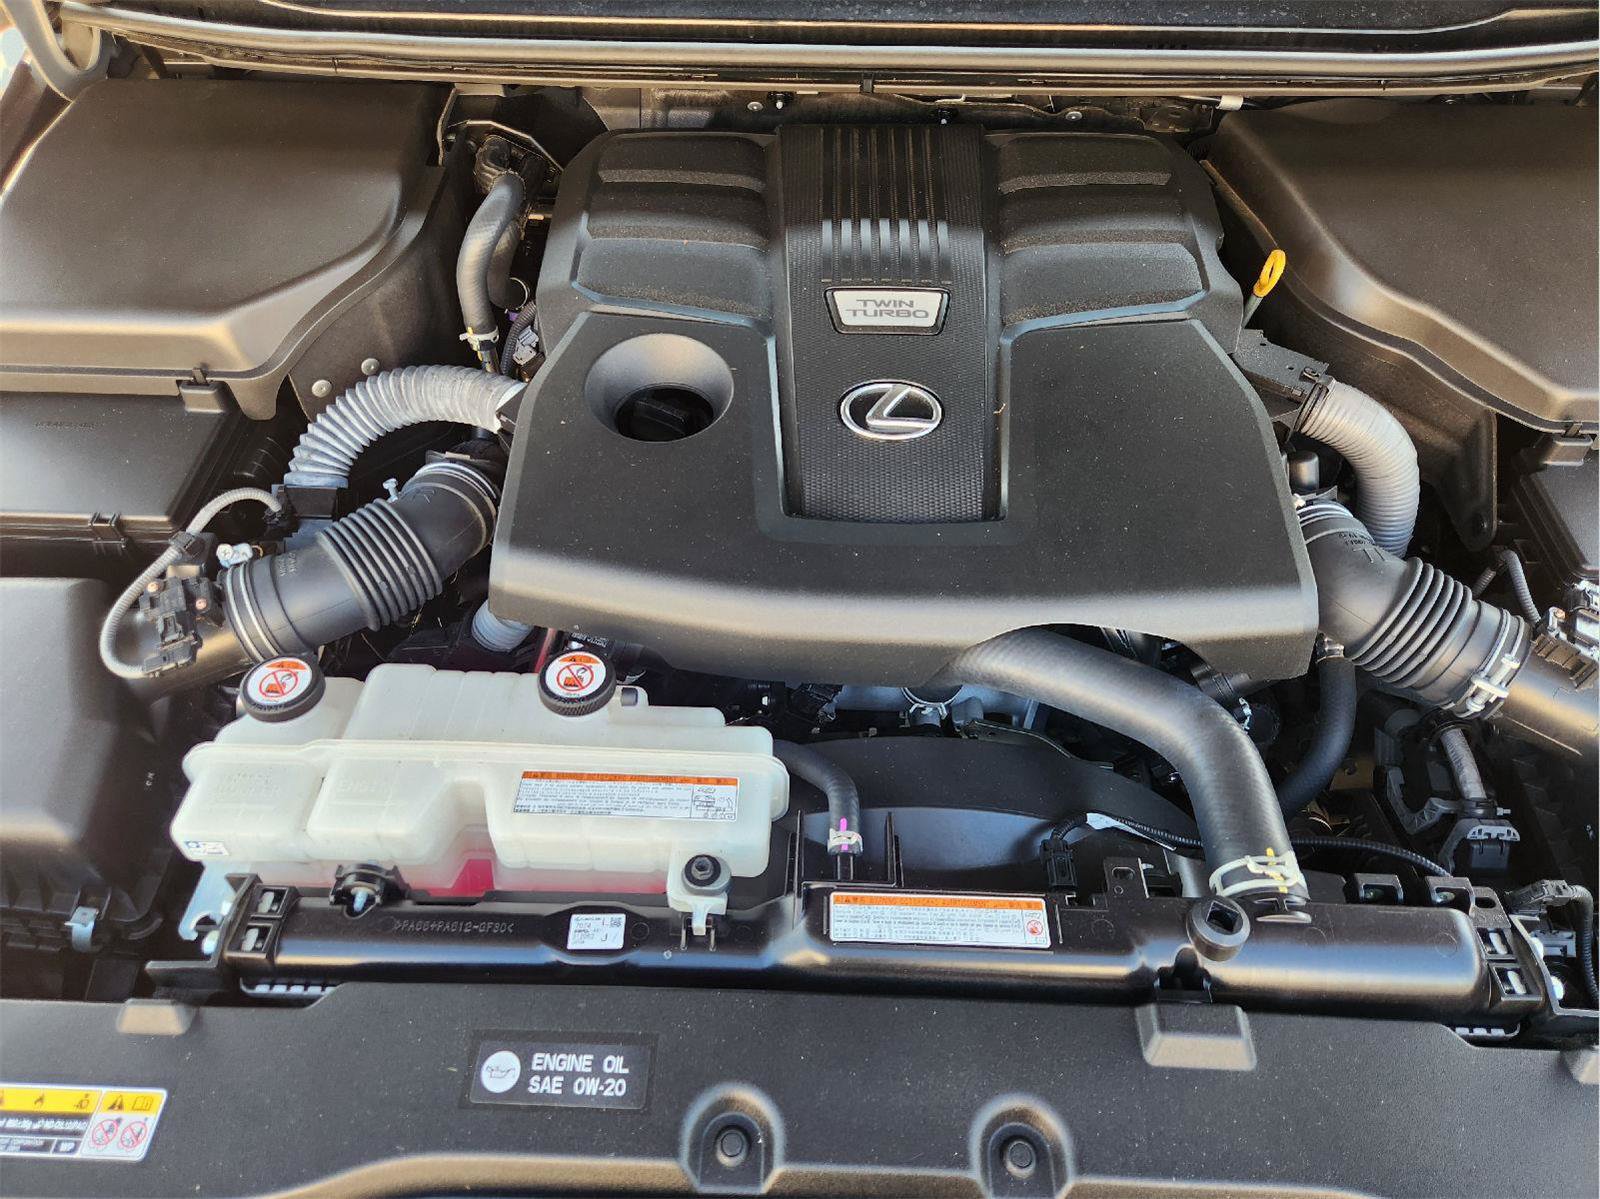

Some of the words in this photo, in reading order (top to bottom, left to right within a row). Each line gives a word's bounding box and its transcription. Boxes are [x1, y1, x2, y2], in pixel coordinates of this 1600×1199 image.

[856, 299, 914, 308] TWIN
[845, 308, 929, 319] TURBO
[531, 1052, 594, 1072] ENGINE
[602, 1055, 630, 1074] OIL
[528, 1075, 564, 1095] SAE
[573, 1077, 627, 1097] 0W-20
